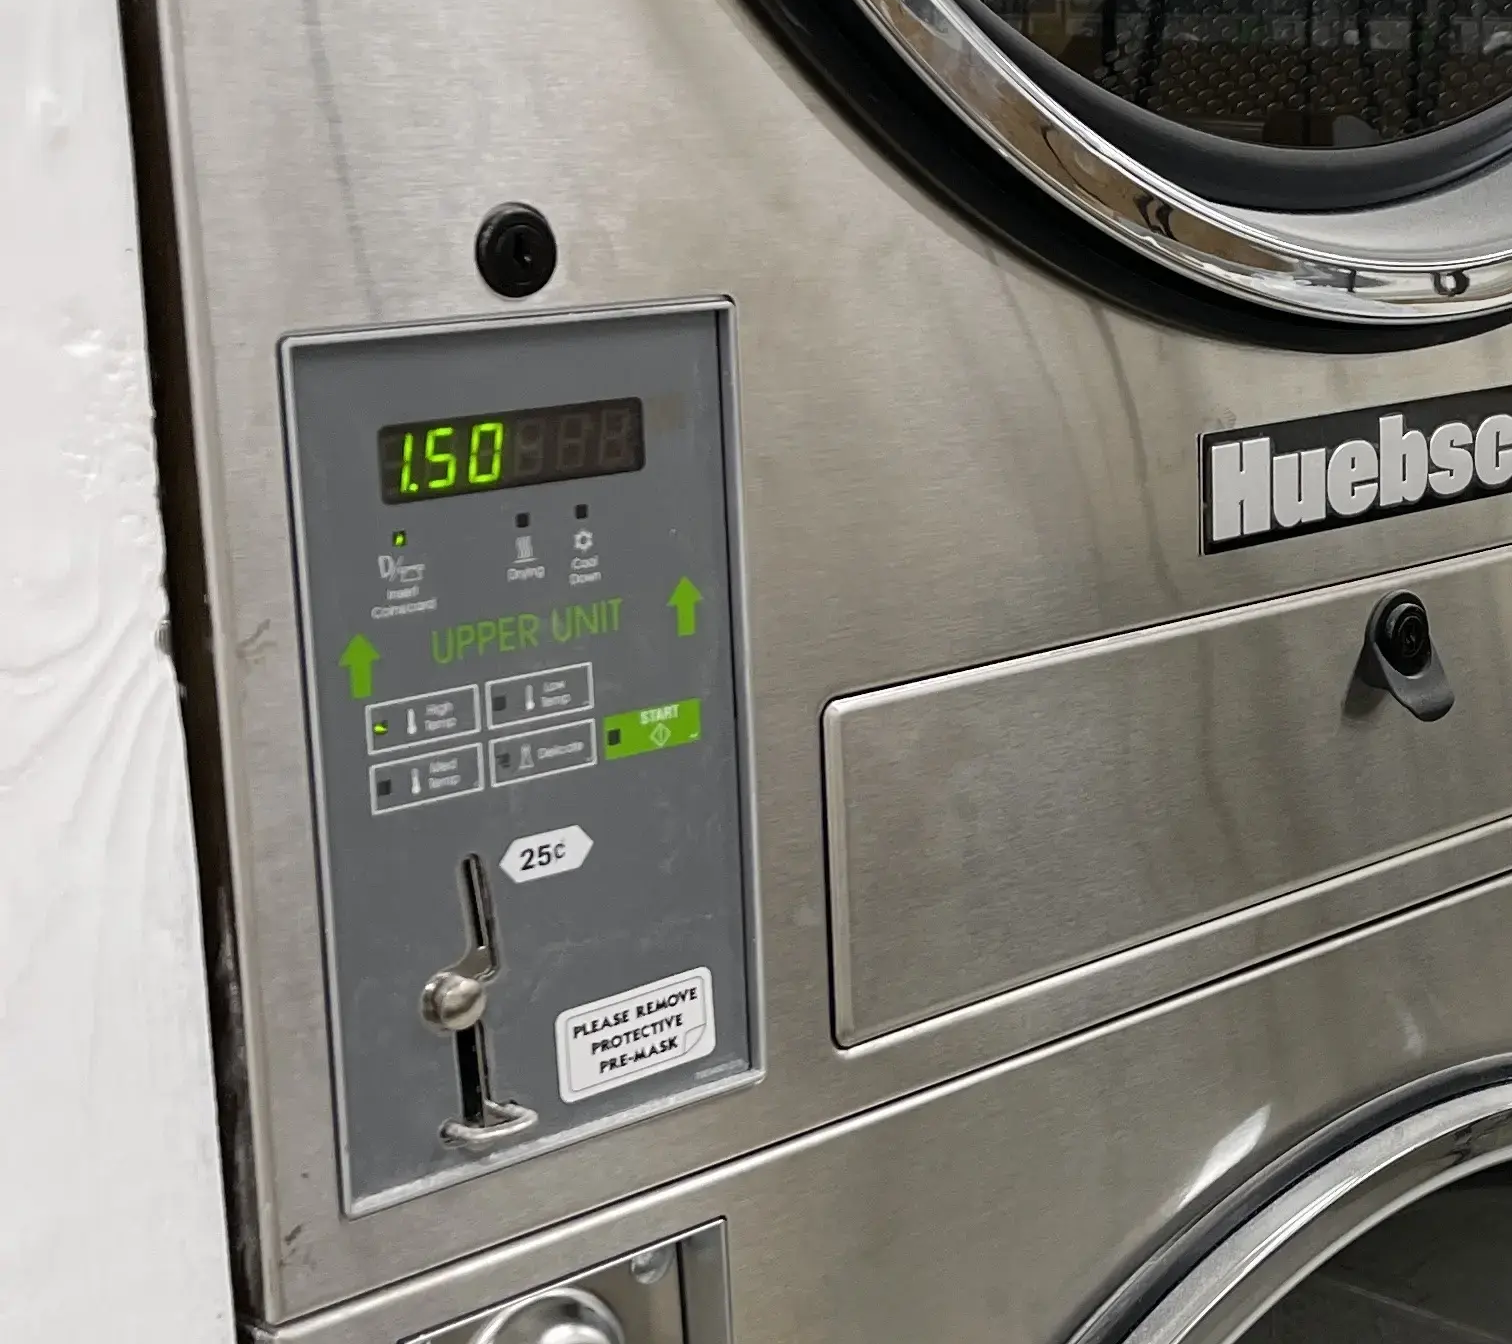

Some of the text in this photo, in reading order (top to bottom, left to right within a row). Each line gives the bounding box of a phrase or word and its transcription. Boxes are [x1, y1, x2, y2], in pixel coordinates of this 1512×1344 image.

[400, 421, 504, 493] 1.50
[431, 597, 624, 665] UPPER UNIT
[639, 703, 681, 725] START
[572, 987, 699, 1039] PLEASE REMOVE
[591, 1013, 684, 1056] PROTECTIVE
[598, 1036, 680, 1074] PRE-MASK
